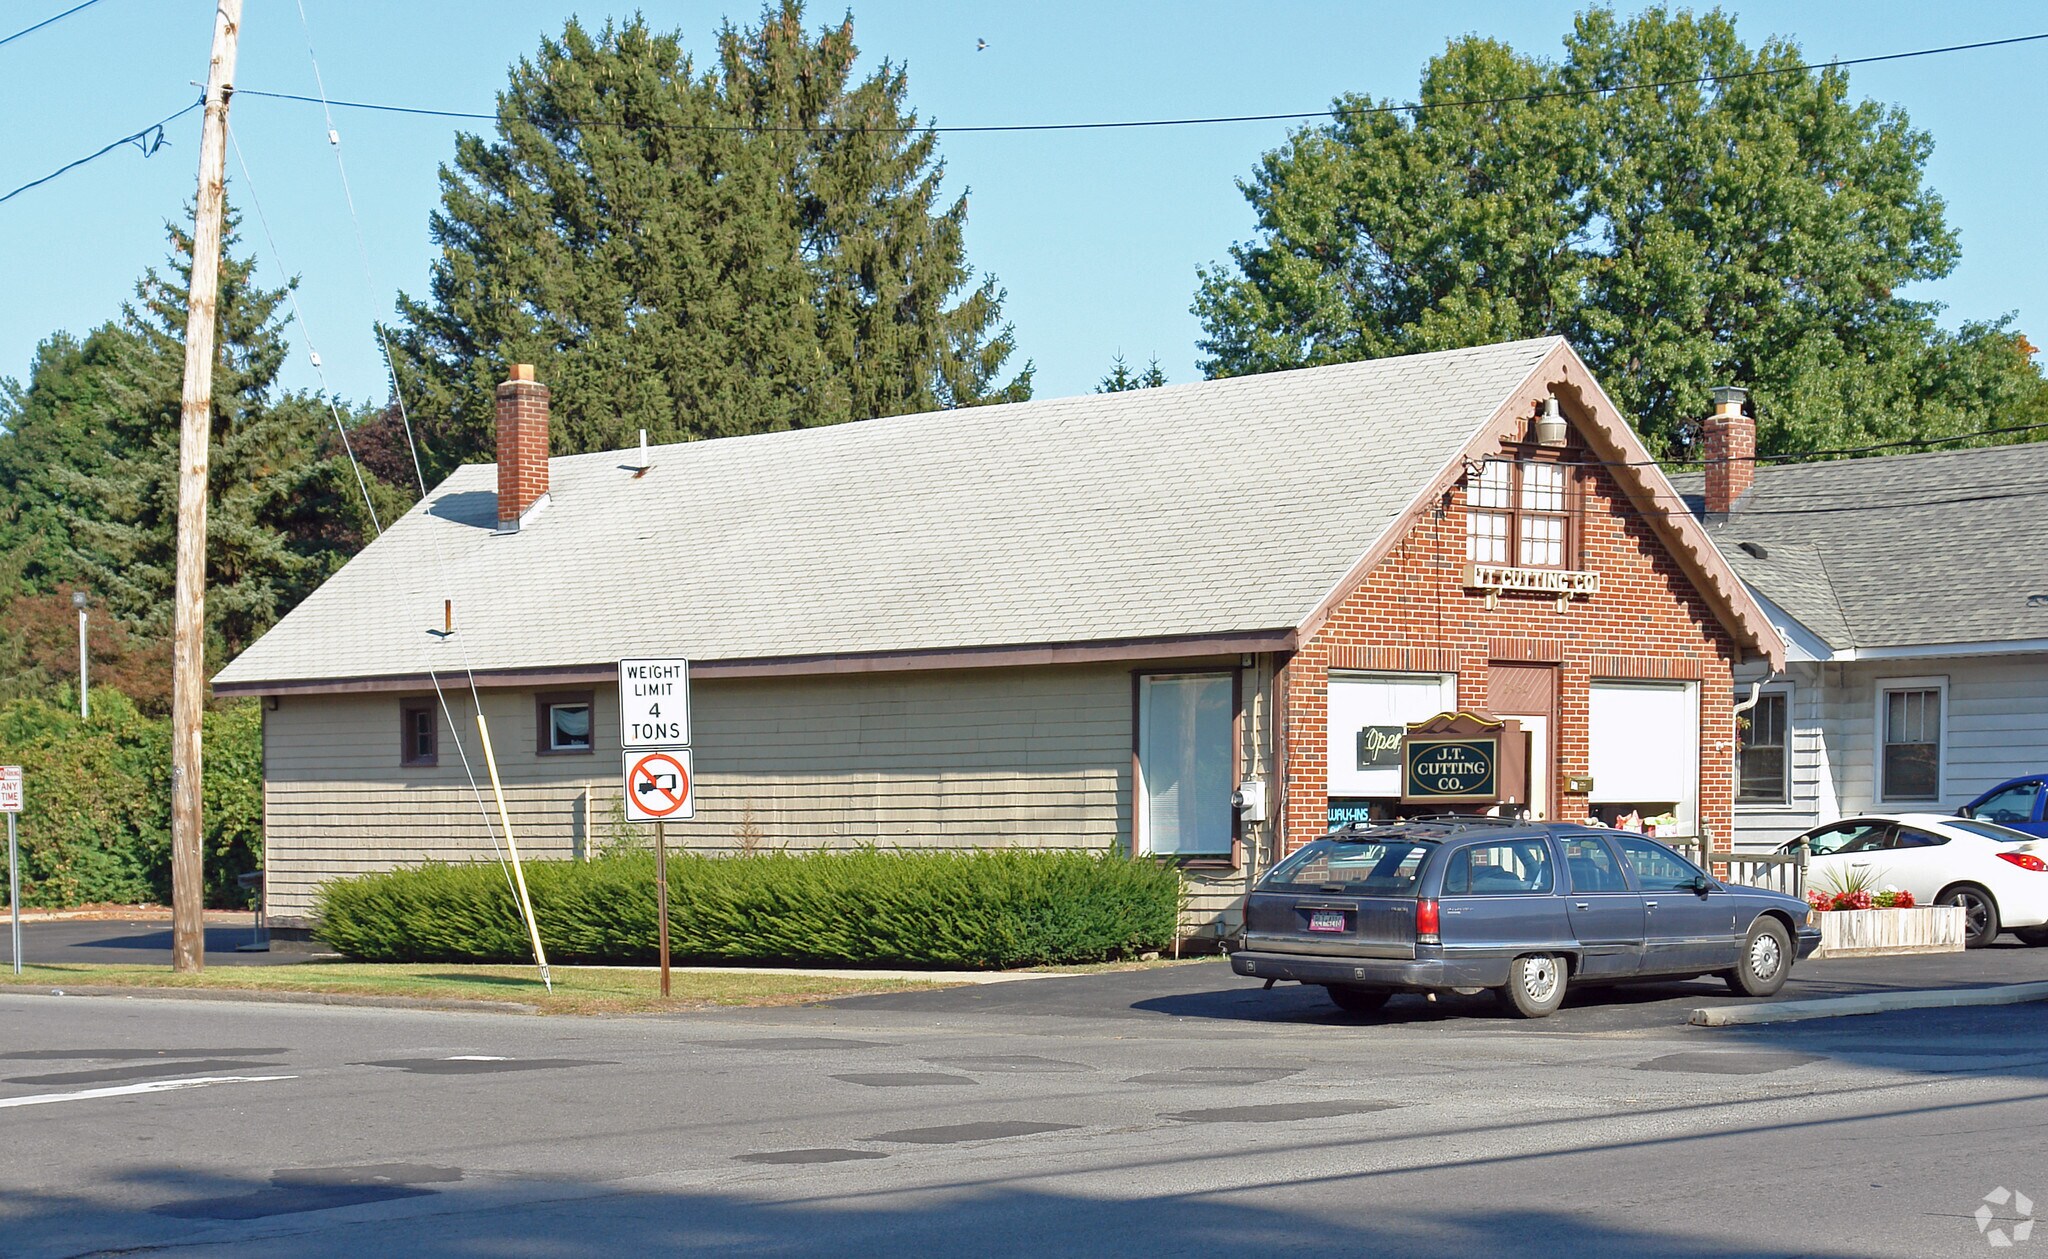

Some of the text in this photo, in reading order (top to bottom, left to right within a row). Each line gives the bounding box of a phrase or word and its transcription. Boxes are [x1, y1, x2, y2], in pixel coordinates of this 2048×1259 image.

[1500, 570, 1569, 590] CUTTING
[1574, 573, 1595, 591] CO
[627, 665, 681, 679] WEIGHT
[634, 683, 673, 696] LIMIT
[648, 702, 661, 718] 4
[631, 722, 680, 739] TONS
[1436, 747, 1465, 761] J.T.
[1417, 761, 1485, 775] CUTTING
[1, 782, 18, 791] ANY
[1437, 777, 1464, 790] CO.
[1, 792, 18, 801] TIME
[1327, 808, 1369, 821] WALK-INS
